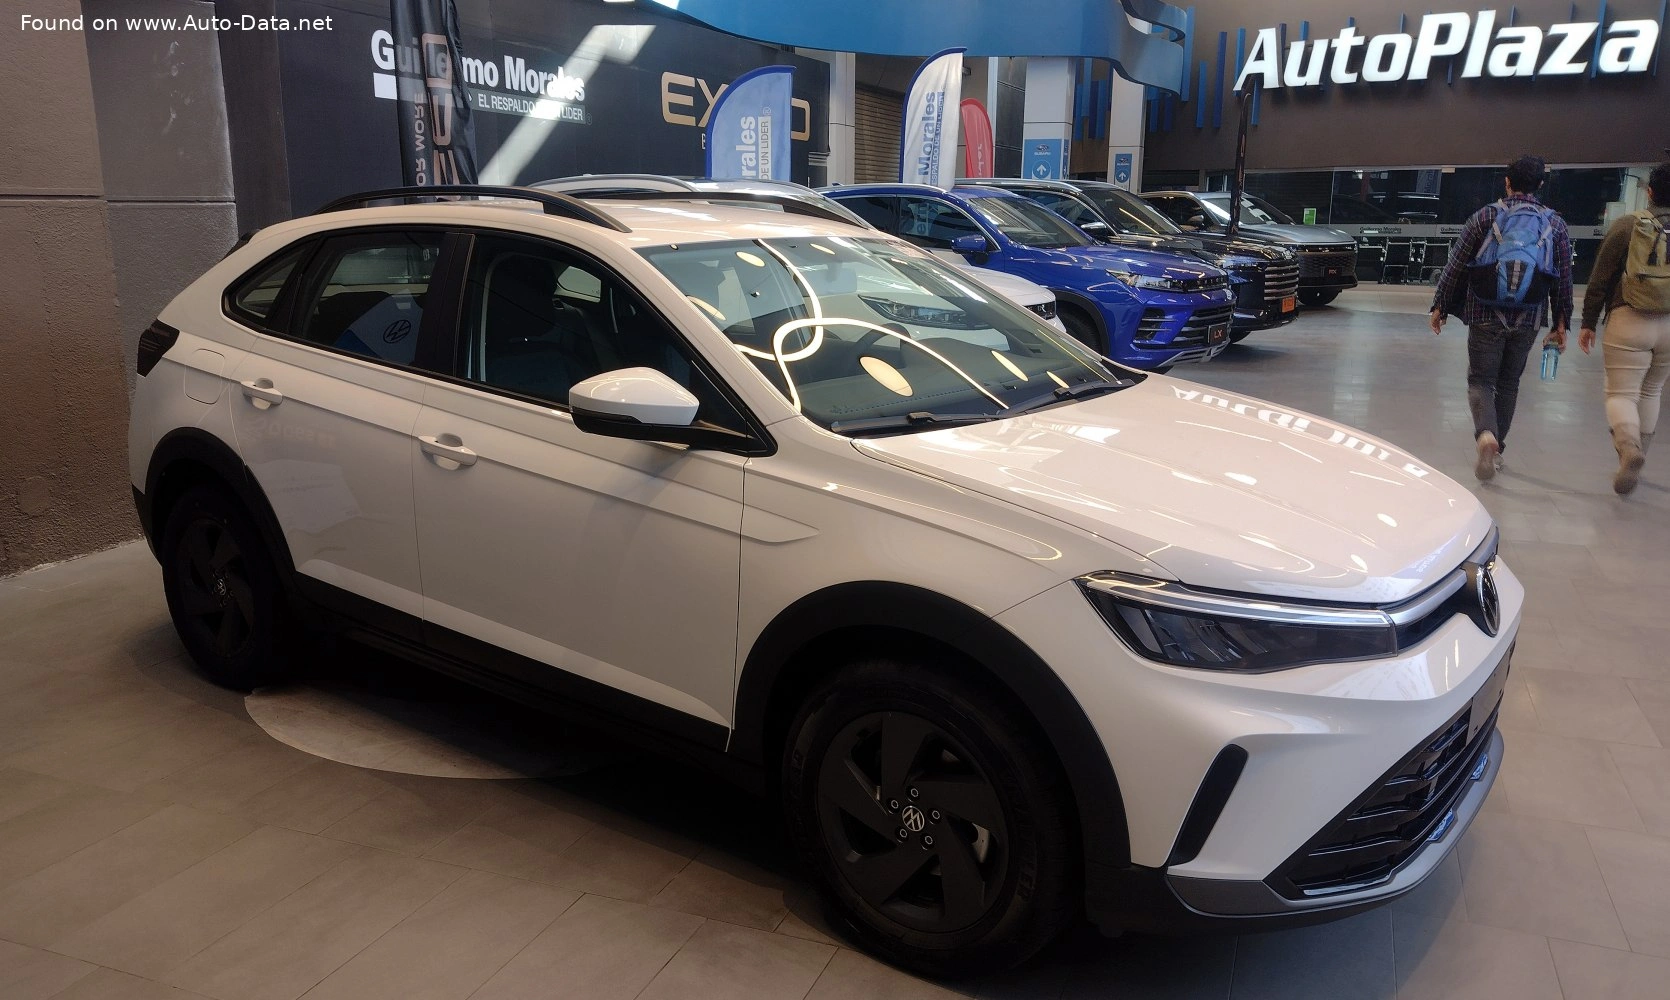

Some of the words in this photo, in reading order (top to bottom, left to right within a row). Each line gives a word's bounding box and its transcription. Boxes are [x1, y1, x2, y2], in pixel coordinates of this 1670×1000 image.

[1233, 9, 1660, 91] AutoPlaza
[504, 54, 585, 101] Morales
[478, 93, 490, 108] EL
[760, 121, 769, 149] LIDER
[917, 92, 935, 176] Morales
[760, 151, 769, 165] UN
